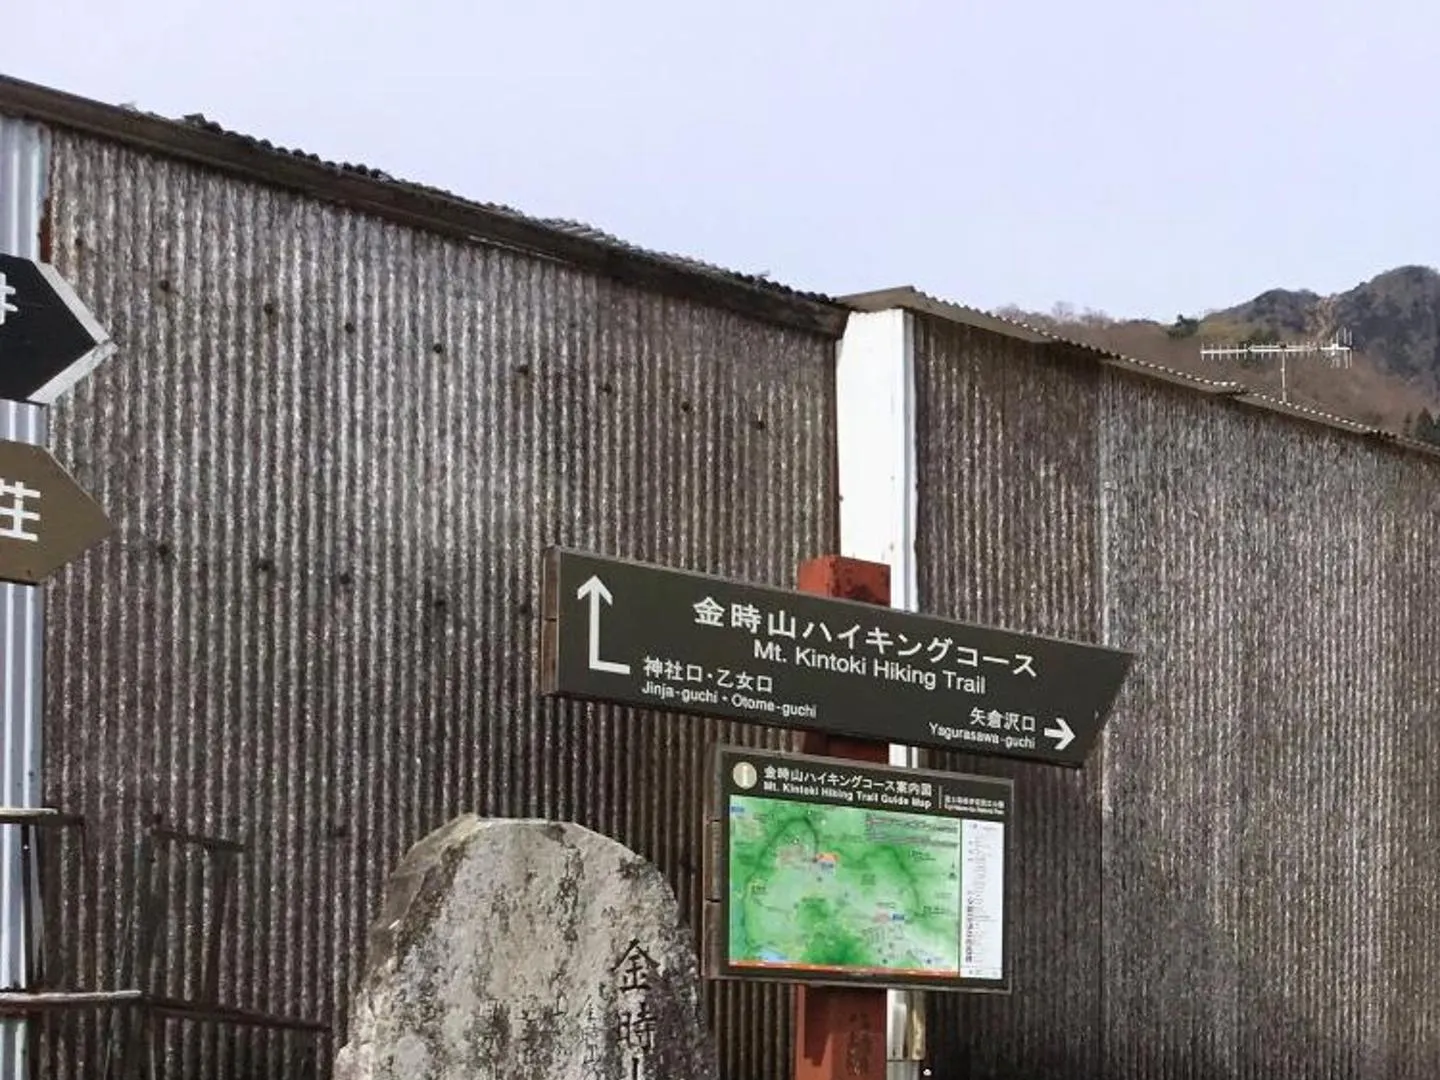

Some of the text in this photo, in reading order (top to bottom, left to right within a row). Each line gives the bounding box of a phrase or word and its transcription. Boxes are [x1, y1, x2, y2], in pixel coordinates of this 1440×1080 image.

[692, 596, 1037, 678] 金時山ハイキングコース
[642, 656, 773, 693] 神社口・乙女口
[753, 638, 987, 695] Mt. Kintoki Hiking Trail
[928, 721, 1036, 749] Yagurasawa-guchi
[969, 706, 1036, 732] 矢倉沢口
[763, 765, 932, 797] 金時山ハイキングコース案内図
